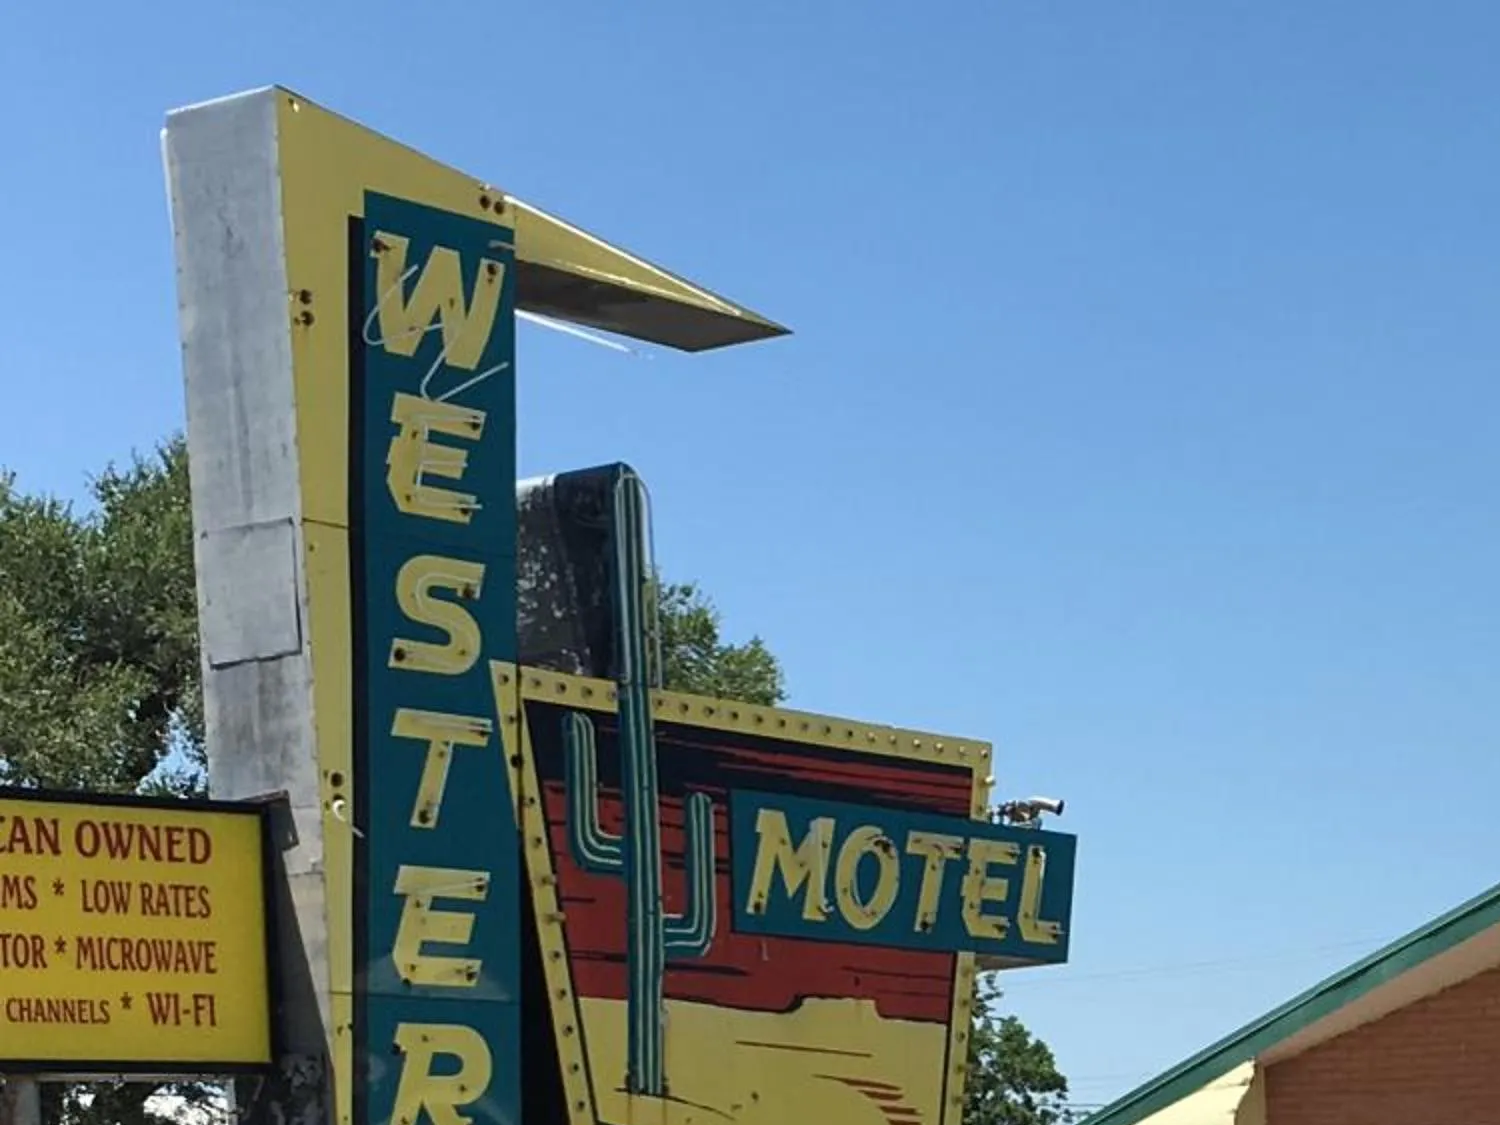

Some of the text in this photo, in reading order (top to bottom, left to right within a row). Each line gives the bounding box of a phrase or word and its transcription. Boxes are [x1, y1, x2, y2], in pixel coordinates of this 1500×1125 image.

[75, 819, 212, 865] OWNED
[1, 873, 212, 919] MS LOW RATES
[746, 808, 1064, 945] MOTEL
[0, 933, 218, 975] TOR MICROWAVE
[5, 992, 218, 1028] CHANNELS WI-FI
